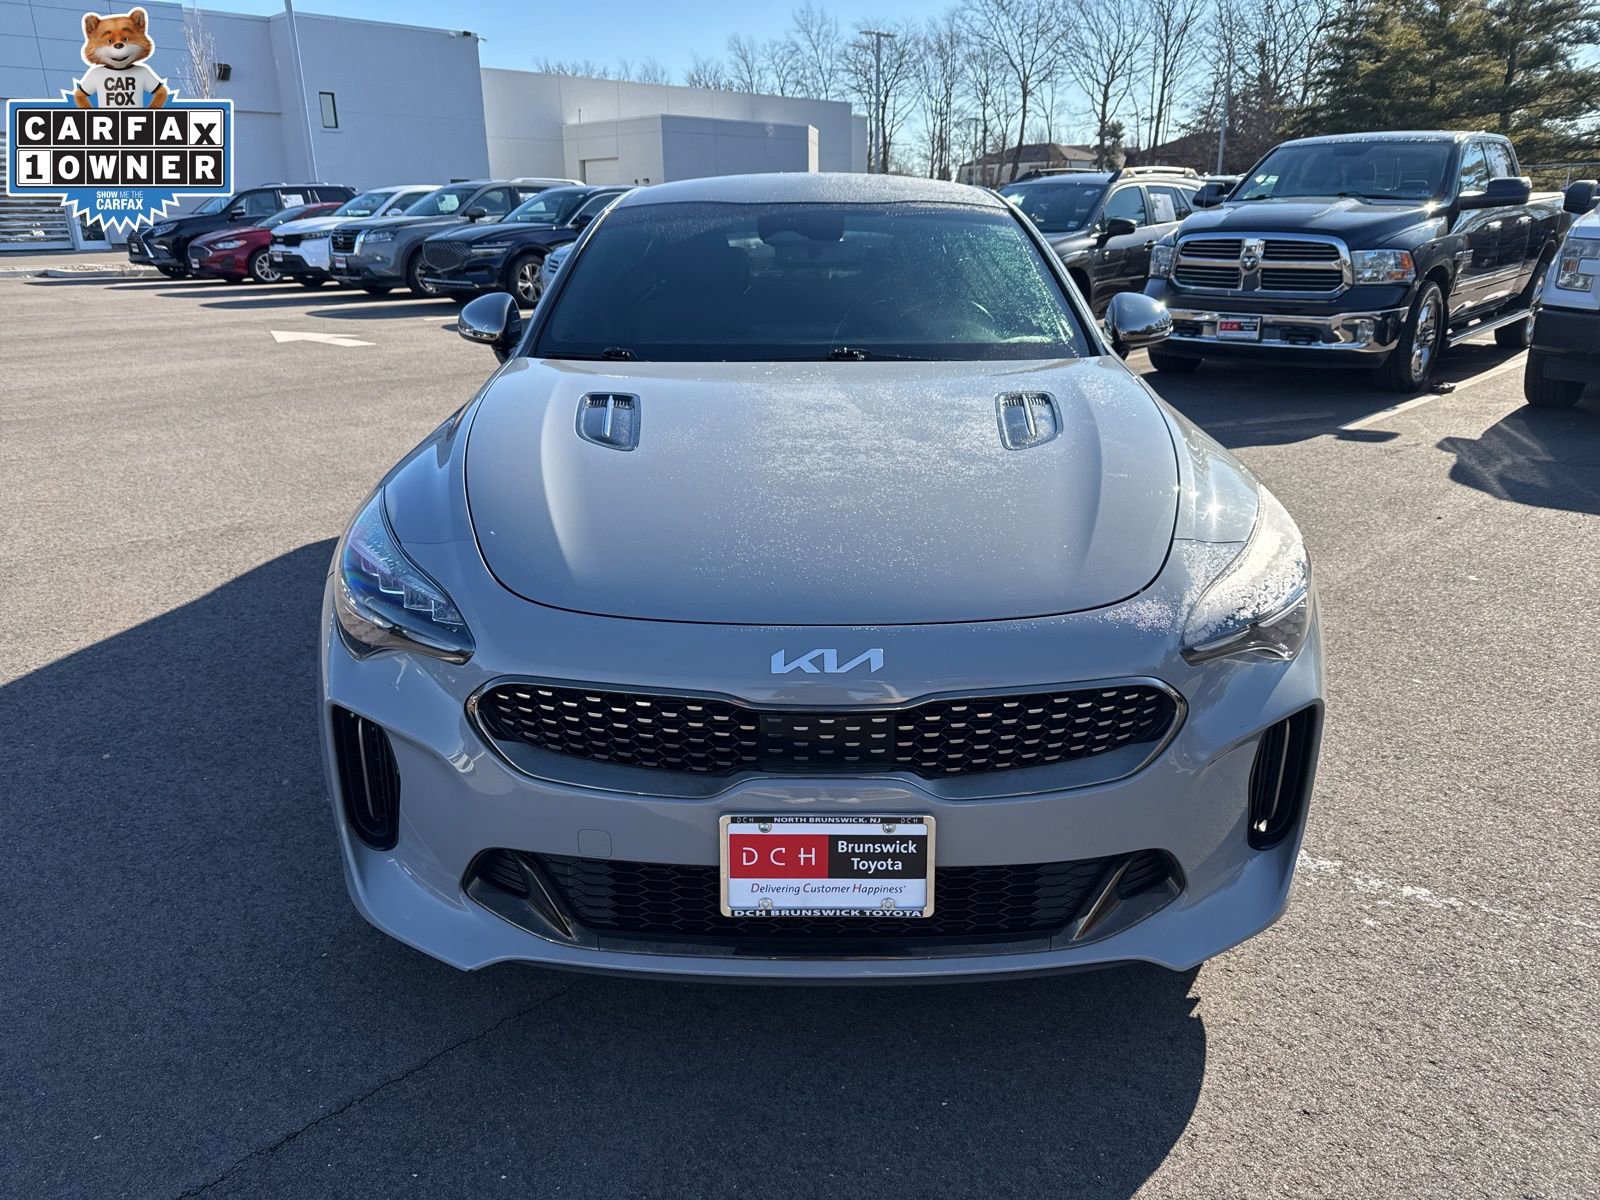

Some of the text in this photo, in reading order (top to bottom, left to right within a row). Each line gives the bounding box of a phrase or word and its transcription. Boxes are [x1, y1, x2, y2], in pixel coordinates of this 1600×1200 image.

[771, 648, 884, 673] KIA
[837, 840, 917, 853] Brunswick
[851, 858, 902, 874] Toyota
[751, 883, 800, 896] Delivering
[803, 883, 850, 893] Customer
